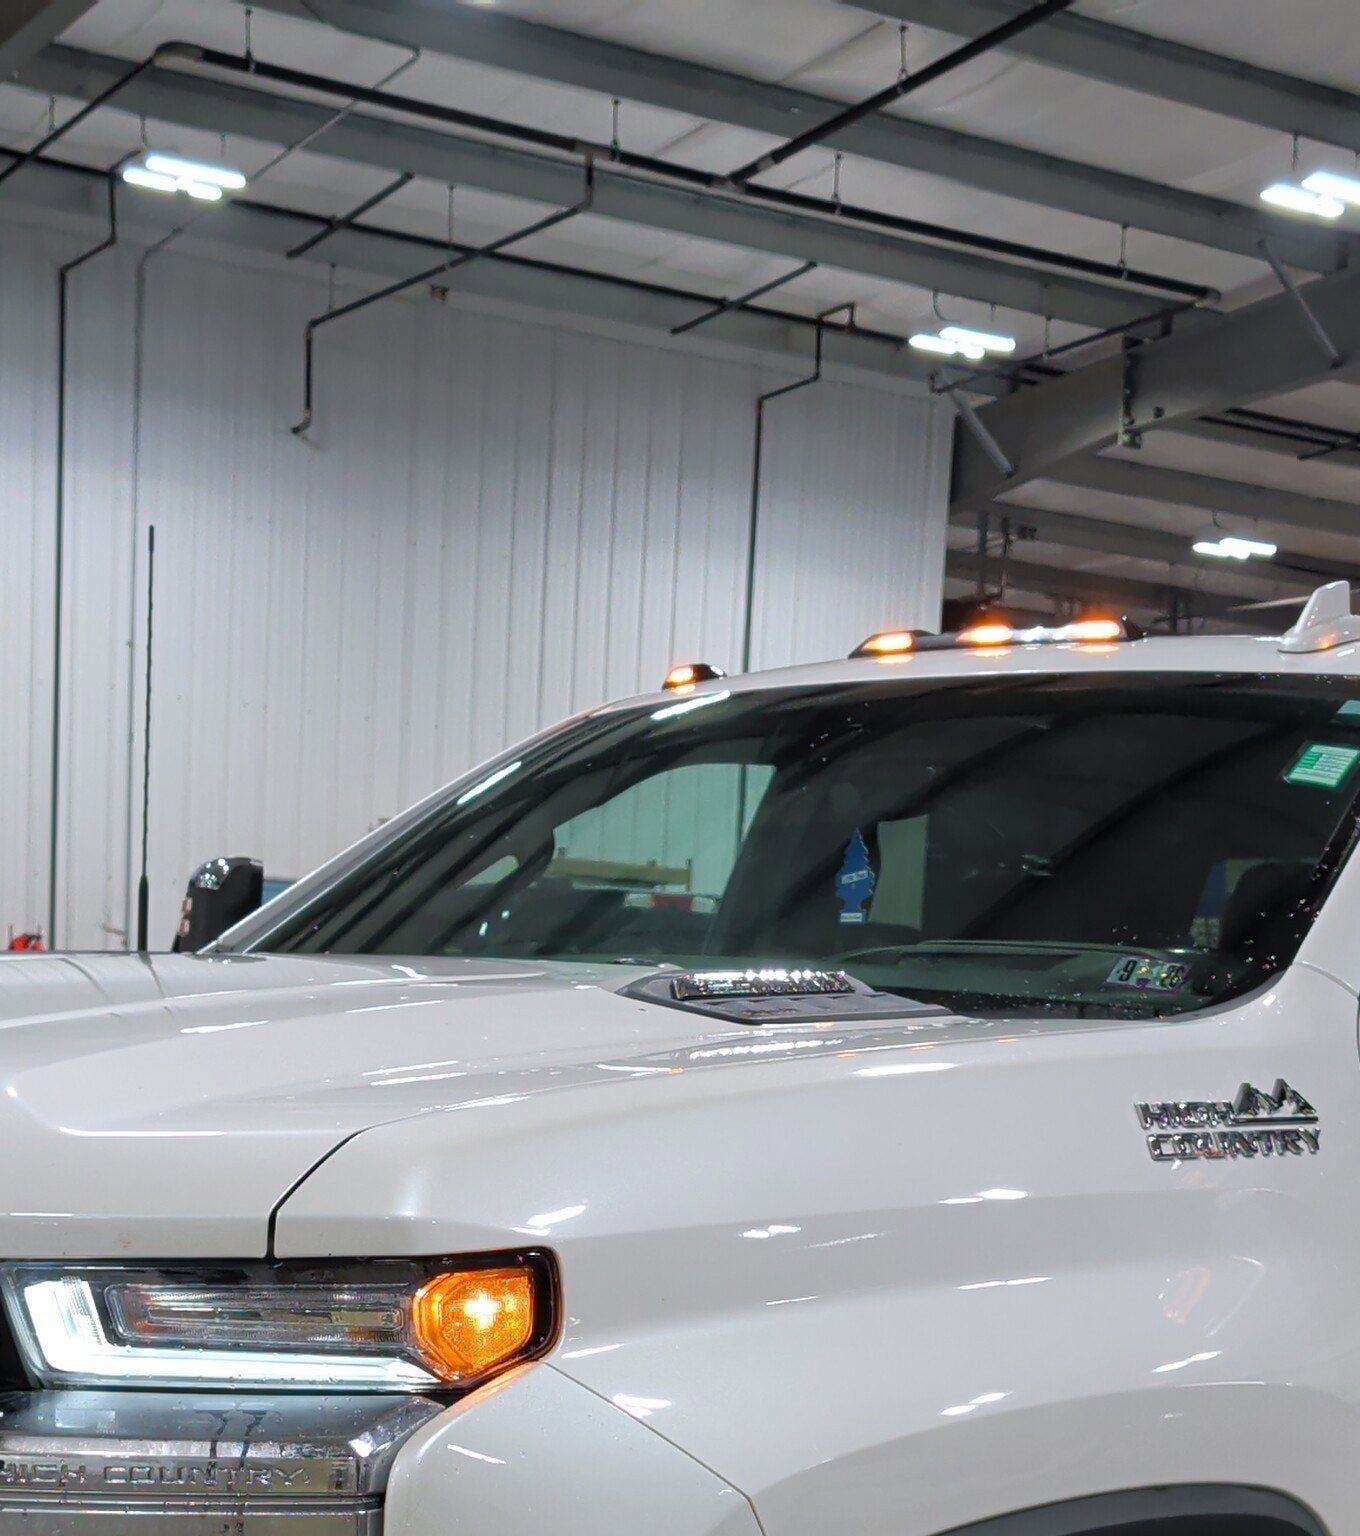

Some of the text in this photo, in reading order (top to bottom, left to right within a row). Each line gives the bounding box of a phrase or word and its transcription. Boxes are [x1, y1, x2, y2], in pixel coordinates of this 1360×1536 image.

[1134, 1100, 1237, 1130] HIGH
[1146, 1127, 1322, 1162] COUNTRY
[103, 1464, 305, 1487] COUNTRY
